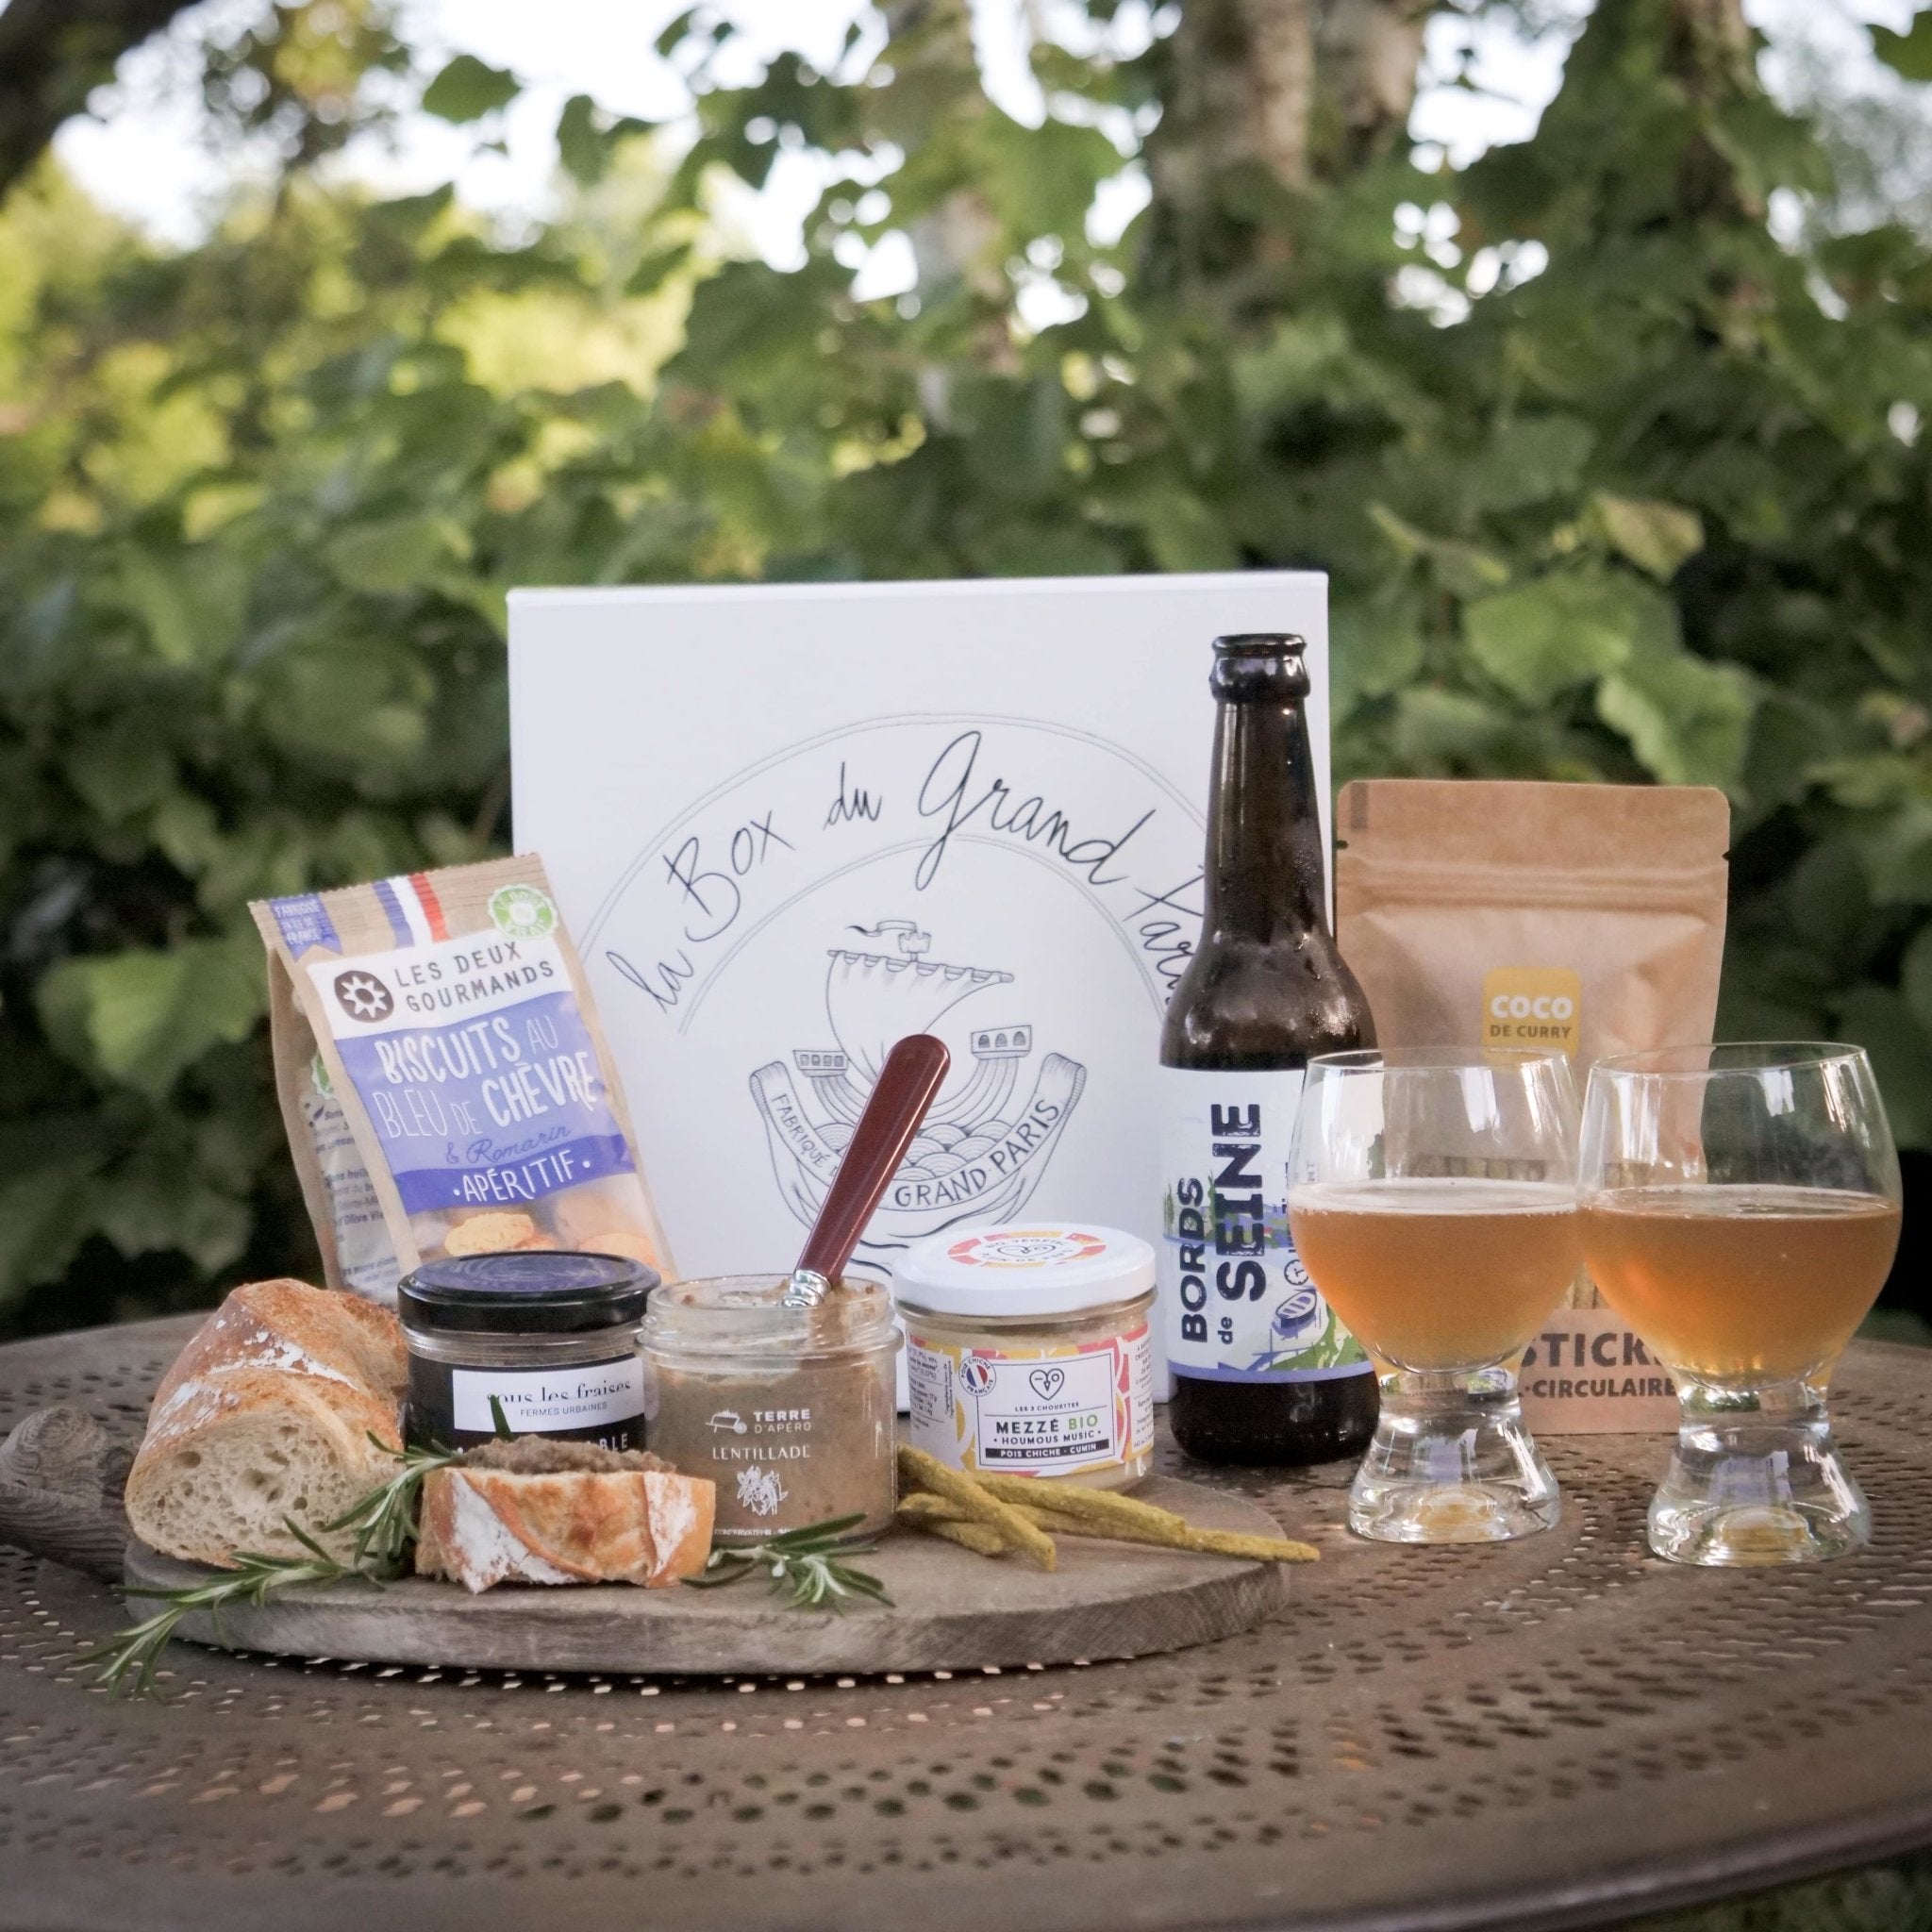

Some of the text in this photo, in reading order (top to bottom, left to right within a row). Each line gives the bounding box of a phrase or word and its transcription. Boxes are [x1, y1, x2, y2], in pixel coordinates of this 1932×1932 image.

[607, 949, 693, 1014] la
[663, 810, 795, 941] Box
[823, 761, 882, 830] du
[917, 730, 1156, 891] Grand
[394, 941, 521, 988] LES DEUX
[407, 960, 554, 1012] GOURMANDS
[1491, 995, 1573, 1020] COCO
[374, 1015, 559, 1084] BISCUITS AU
[1491, 1024, 1572, 1039] DE CURRY
[373, 1052, 598, 1138] BLEU DE CHÈVRE
[466, 1125, 572, 1164] Romarin
[772, 1093, 831, 1168] FABRIQUÉ
[894, 1099, 1059, 1208] GRAND PARIS
[1210, 1104, 1266, 1344] de SEINE
[1178, 1177, 1208, 1342] BORDS
[1521, 1332, 1662, 1368] TICK
[577, 1379, 631, 1399] fraises
[1036, 1402, 1080, 1411] CHOUETTES
[520, 1402, 608, 1417] FERMES URBAINES
[753, 1408, 810, 1423] TERRE
[995, 1414, 1098, 1435] MEZZÉ BIO
[755, 1422, 811, 1434] D'APÉRO
[1002, 1430, 1094, 1445] HOUMOUS MUSIC
[1000, 1442, 1097, 1459] POIS CHICHE CUMIN
